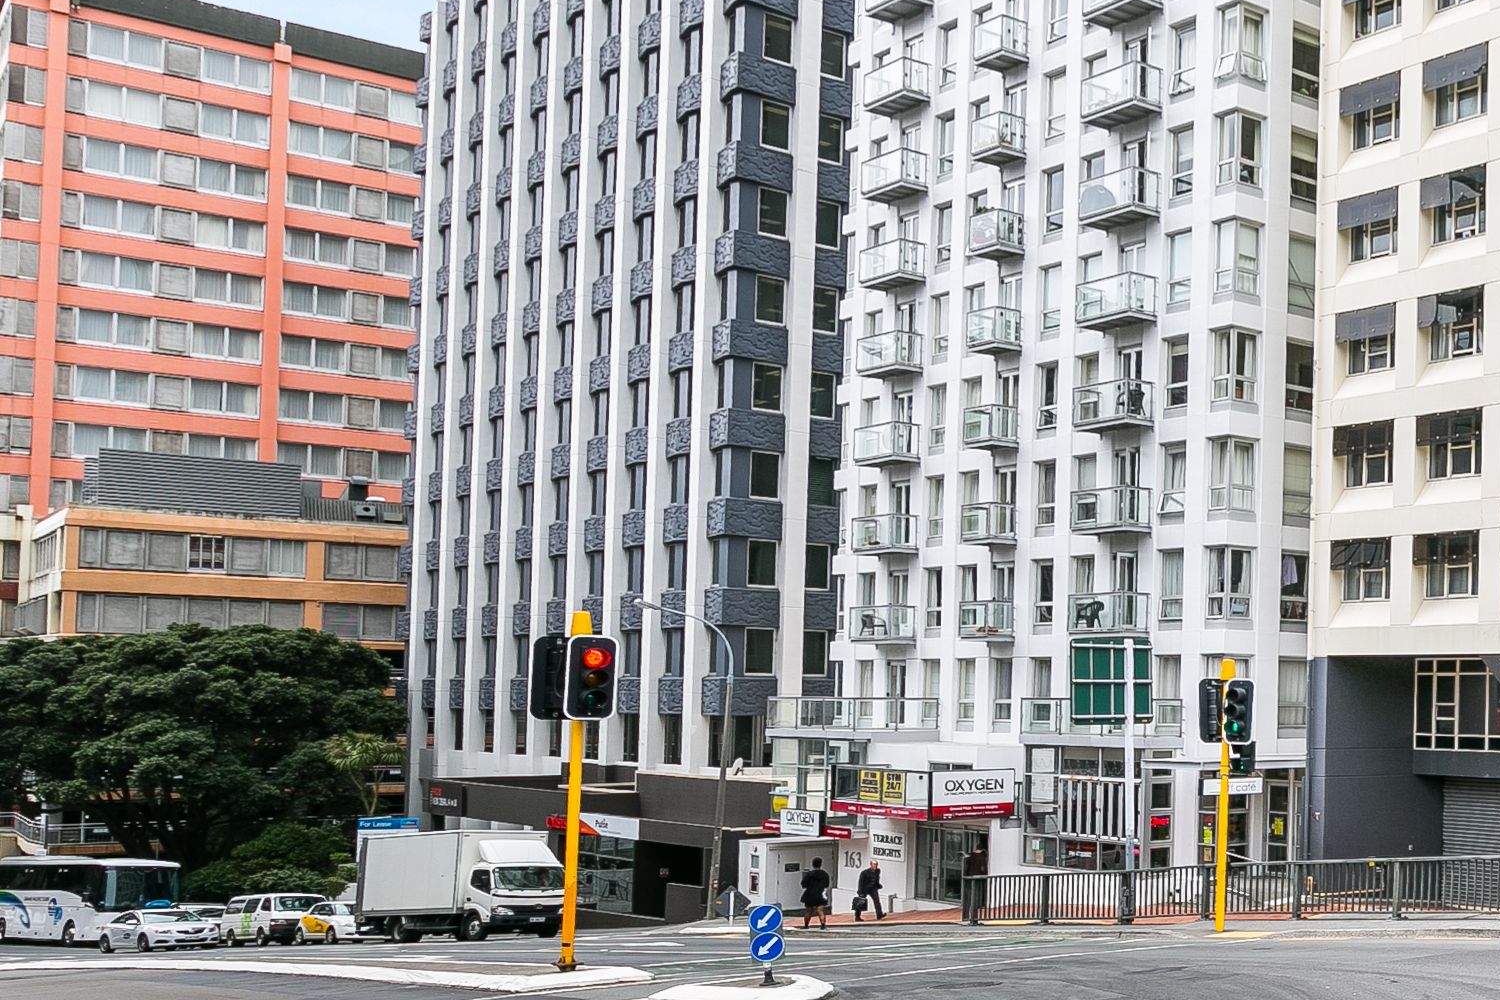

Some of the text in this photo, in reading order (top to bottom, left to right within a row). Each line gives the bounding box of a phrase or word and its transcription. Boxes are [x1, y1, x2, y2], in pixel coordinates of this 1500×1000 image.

[944, 778, 1004, 791] OXYGEN
[786, 810, 815, 824] OXYGEN
[872, 834, 903, 846] TERRACE
[872, 847, 902, 858] HEIGHTS
[844, 850, 862, 869] 163
